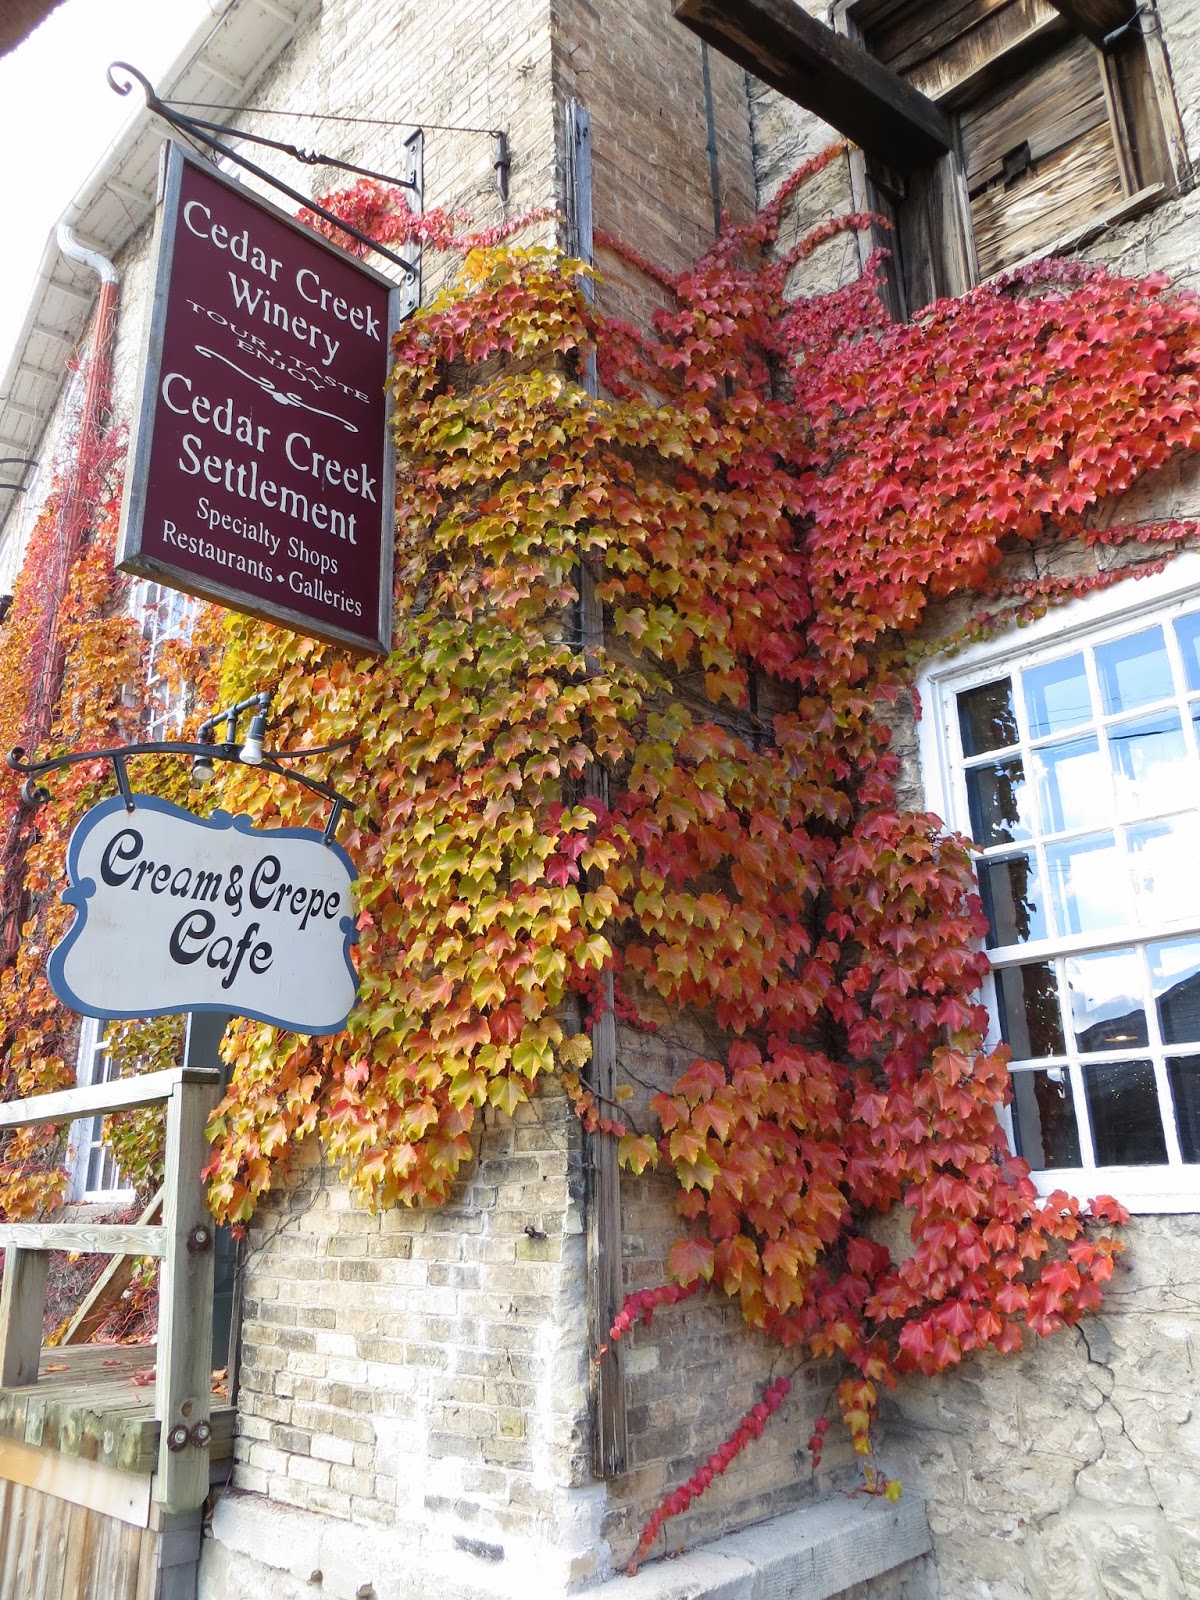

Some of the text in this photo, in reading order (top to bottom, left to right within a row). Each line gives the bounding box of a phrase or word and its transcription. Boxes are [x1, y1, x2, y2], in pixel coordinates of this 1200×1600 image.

[183, 200, 380, 341] Cedar Creek
[228, 271, 340, 366] Winery
[186, 299, 370, 403] TOUR TASTE
[236, 339, 325, 392] ENJOY
[162, 373, 377, 503] Cedar Creek
[179, 434, 357, 545] Settlement
[196, 497, 338, 574] Specialty Shops
[162, 520, 362, 616] Restaurants Galleries
[169, 909, 274, 989] Cafe
